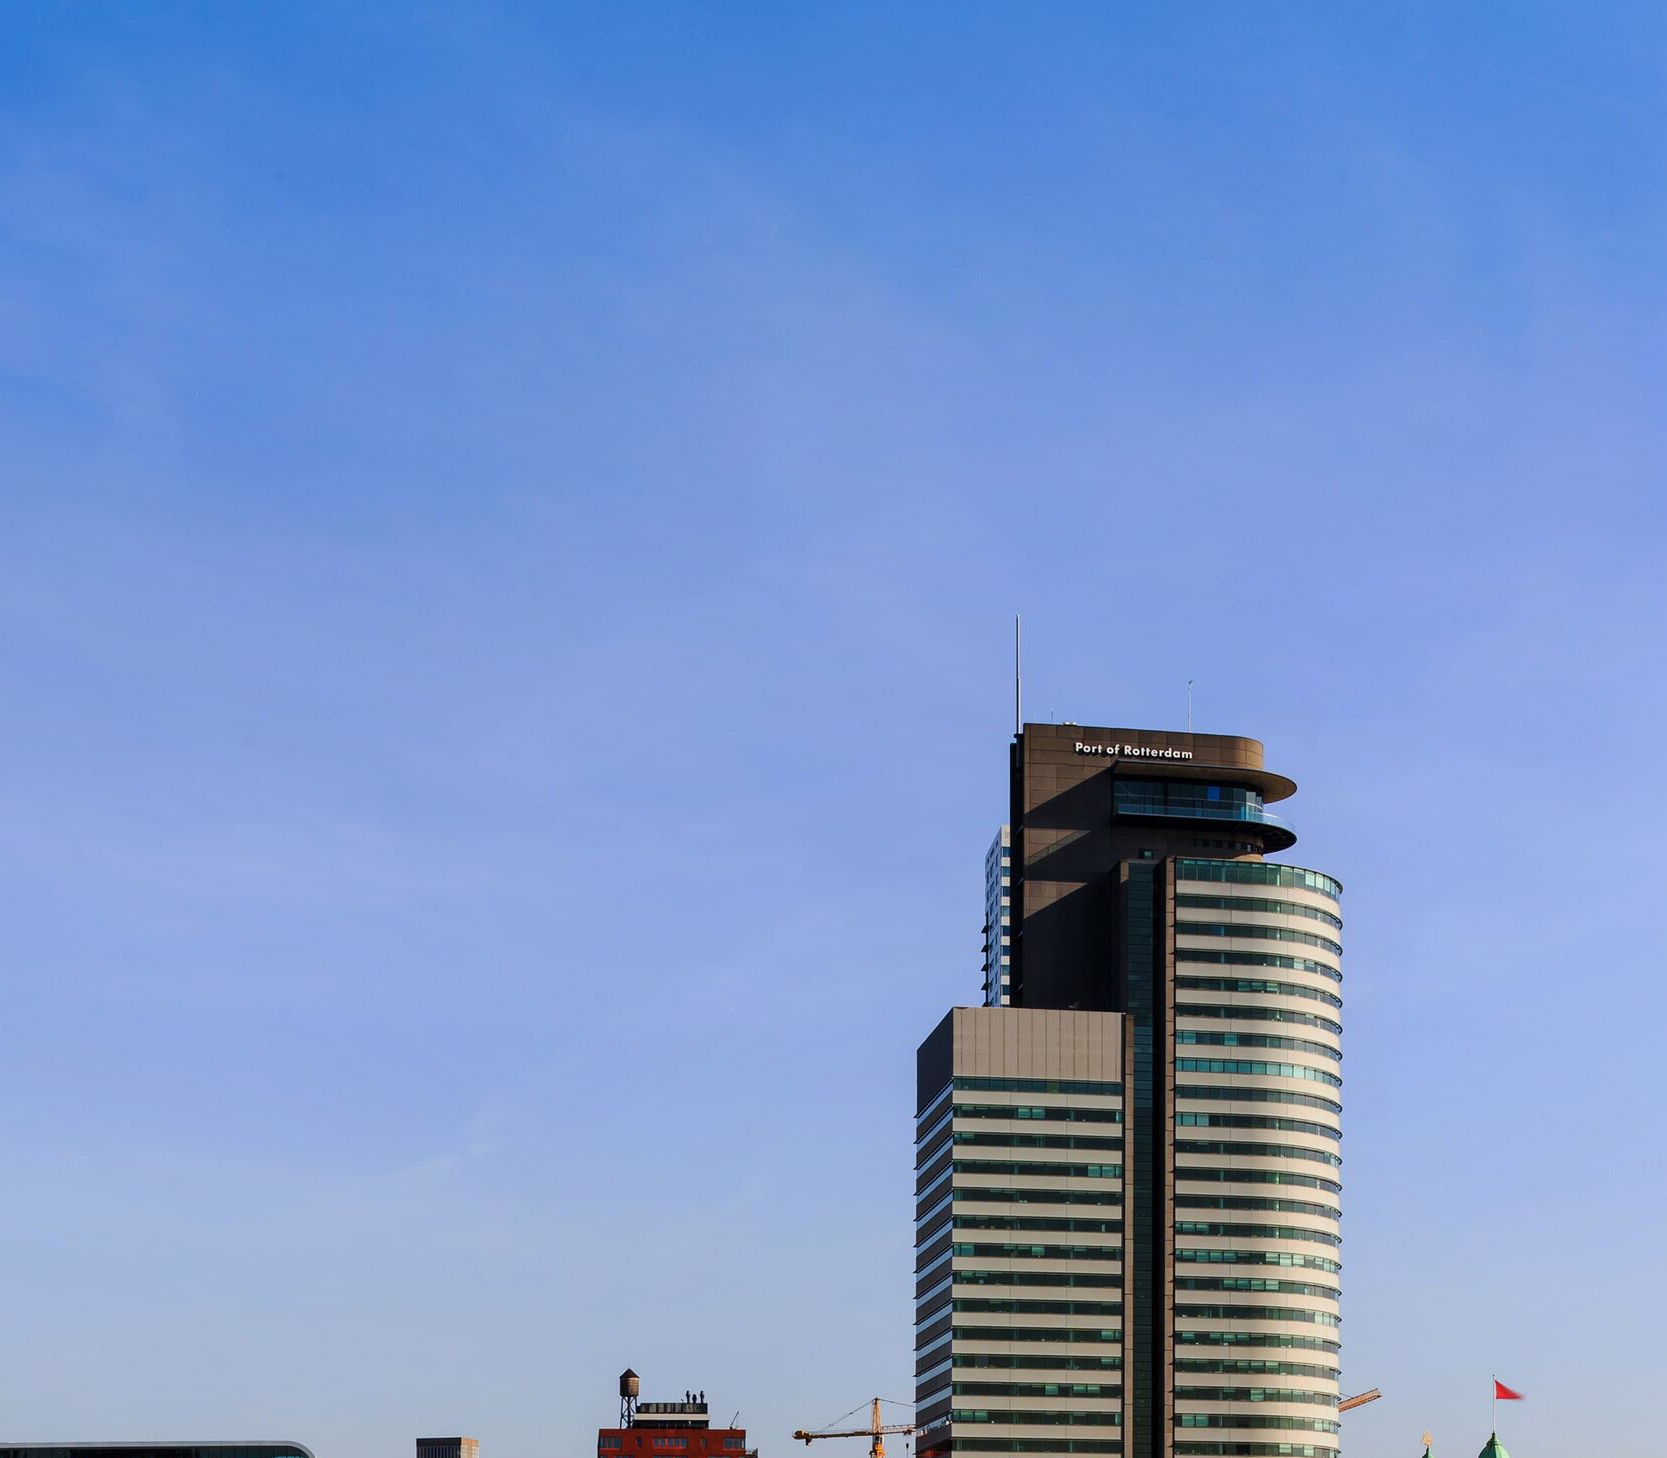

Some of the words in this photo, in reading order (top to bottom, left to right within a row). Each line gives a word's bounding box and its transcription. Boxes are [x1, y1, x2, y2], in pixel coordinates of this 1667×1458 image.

[1075, 742, 1103, 754] Port
[1106, 743, 1120, 755] of
[1124, 745, 1193, 760] Rotterdam
